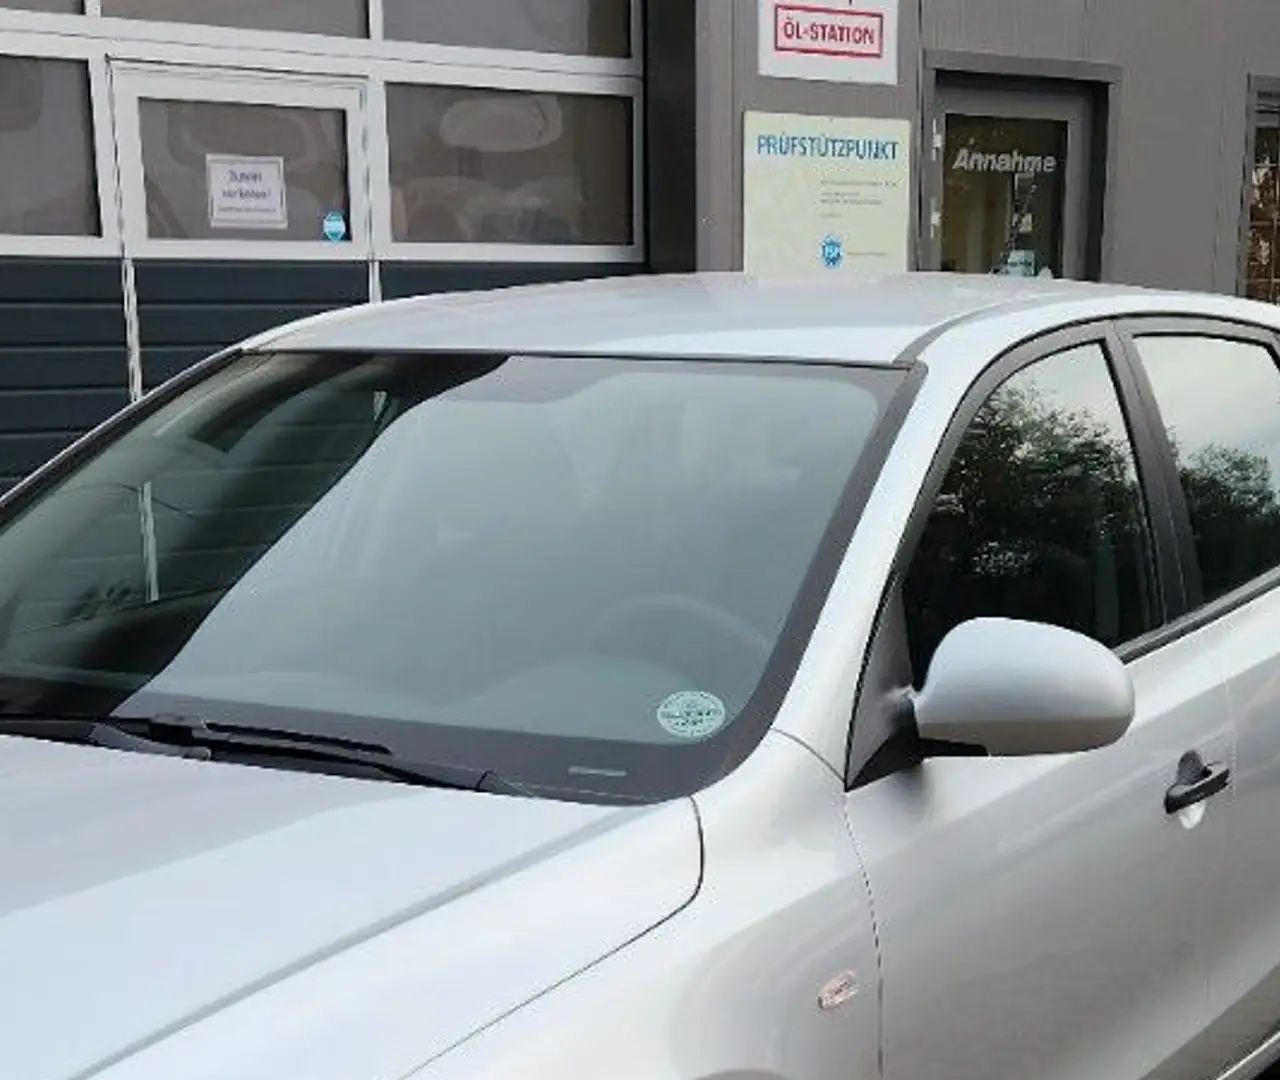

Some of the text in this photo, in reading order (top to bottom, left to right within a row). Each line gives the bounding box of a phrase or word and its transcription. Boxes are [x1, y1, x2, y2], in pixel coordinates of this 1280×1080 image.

[783, 16, 875, 44] ÖL-STATION
[756, 131, 900, 160] PRÜFSTÜTZPUNKT
[952, 147, 1057, 172] Annahme
